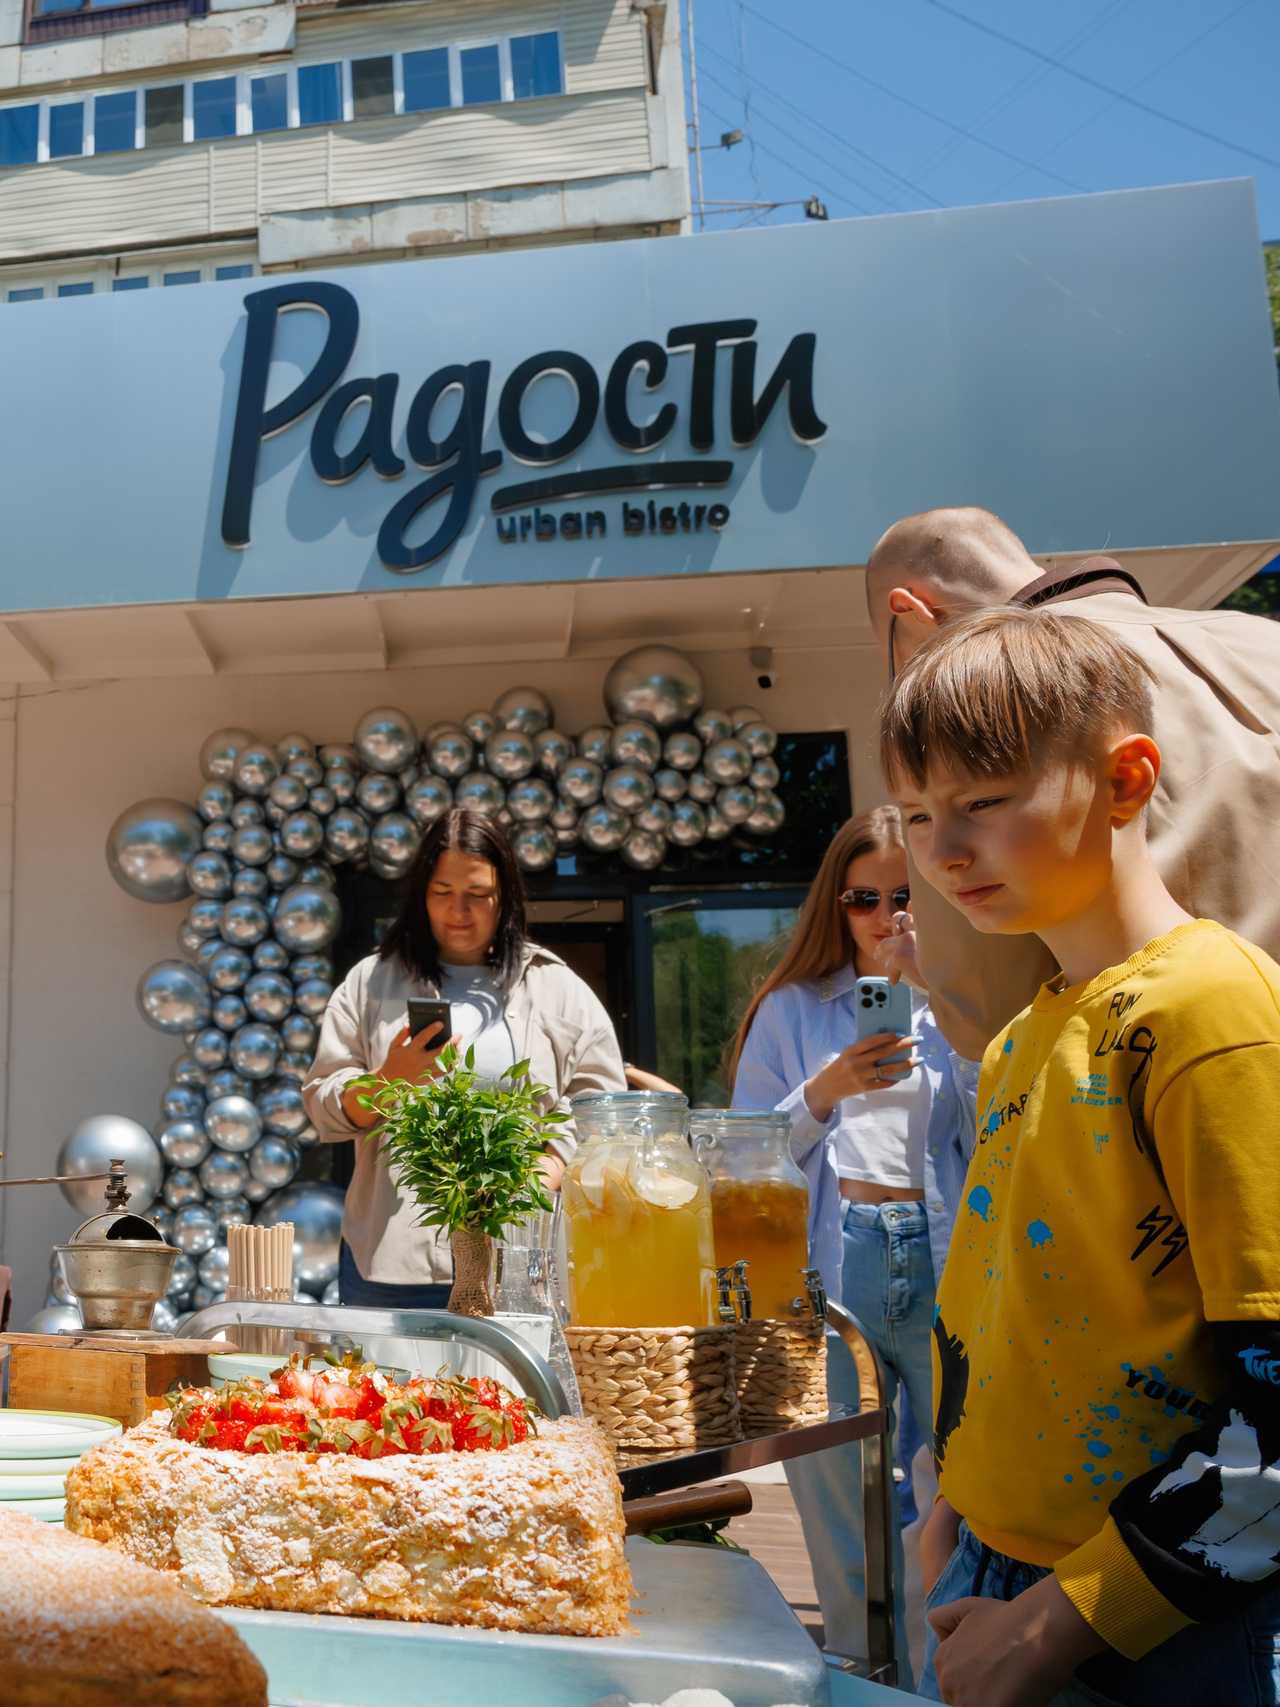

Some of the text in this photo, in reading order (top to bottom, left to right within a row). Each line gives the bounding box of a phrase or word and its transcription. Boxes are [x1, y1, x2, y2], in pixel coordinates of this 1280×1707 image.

[496, 500, 730, 544] urban bistro
[1108, 992, 1143, 1020] FUN
